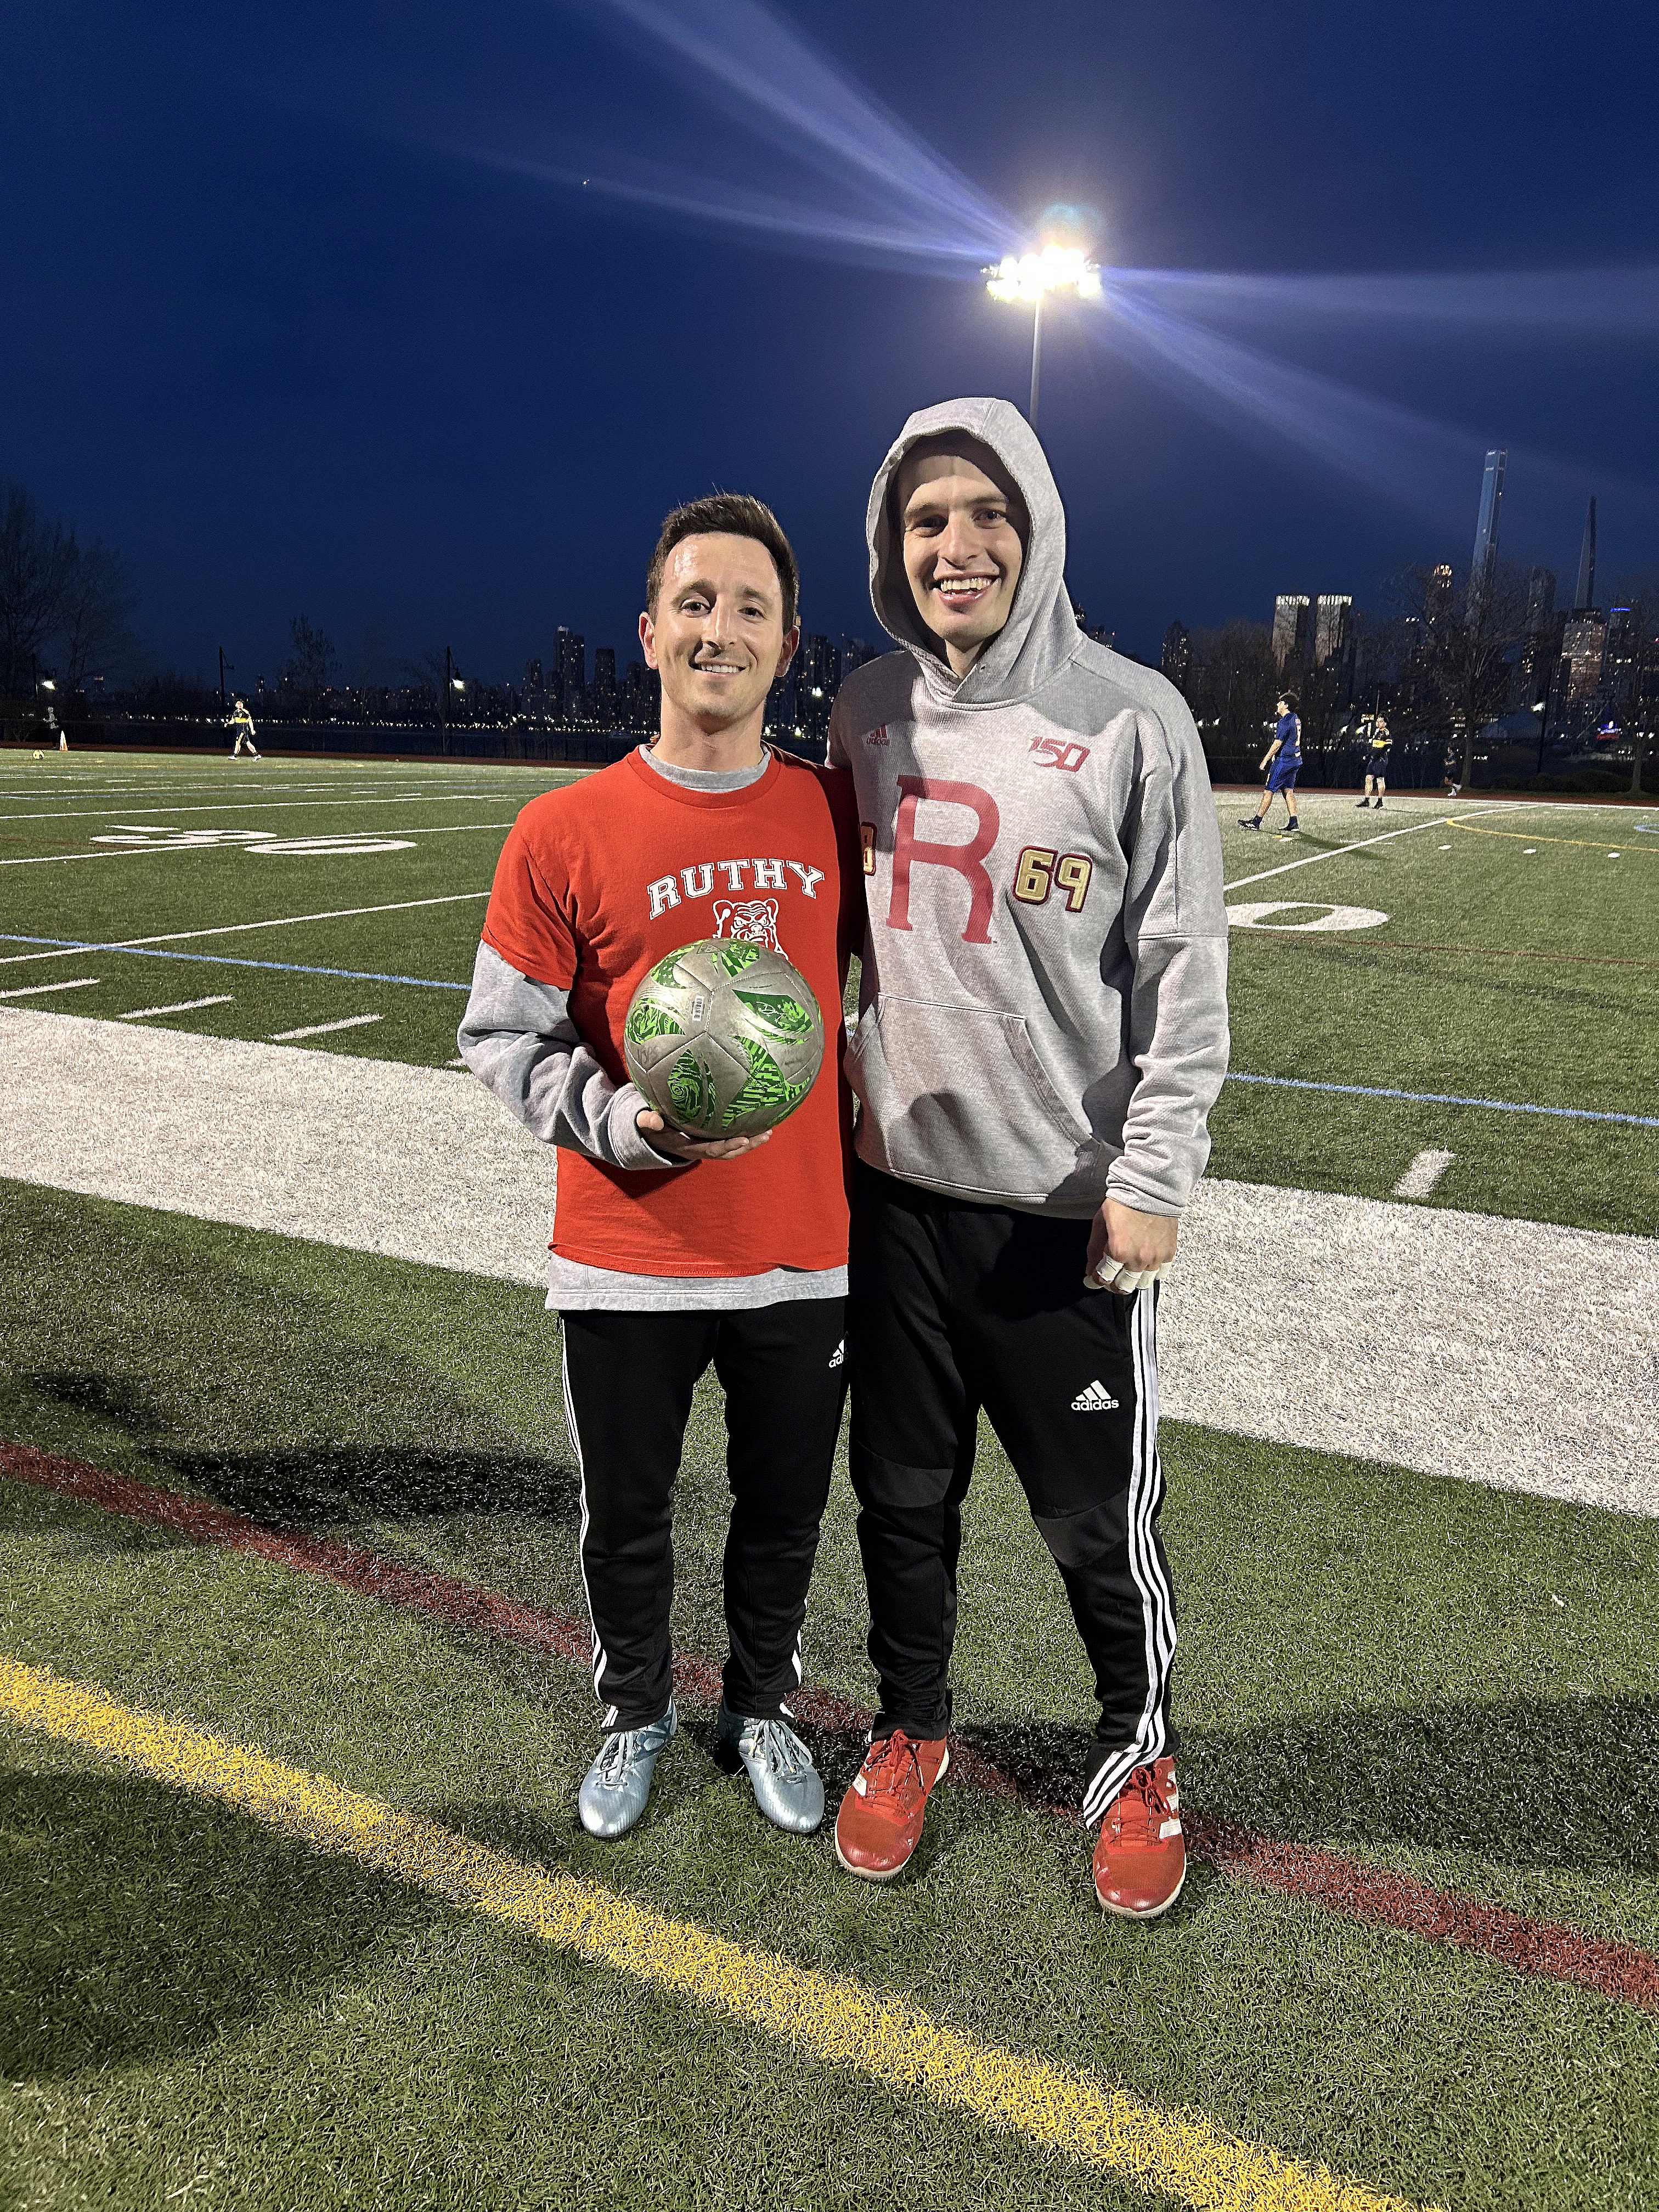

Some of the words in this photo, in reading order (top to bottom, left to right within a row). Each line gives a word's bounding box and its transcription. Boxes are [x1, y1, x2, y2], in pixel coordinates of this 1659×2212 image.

[1028, 736, 1091, 772] 150
[886, 775, 1000, 944] R
[1013, 845, 1092, 913] 69
[646, 858, 825, 921] RUTHY
[828, 1353, 844, 1368] adi
[1071, 1399, 1119, 1411] adidas
